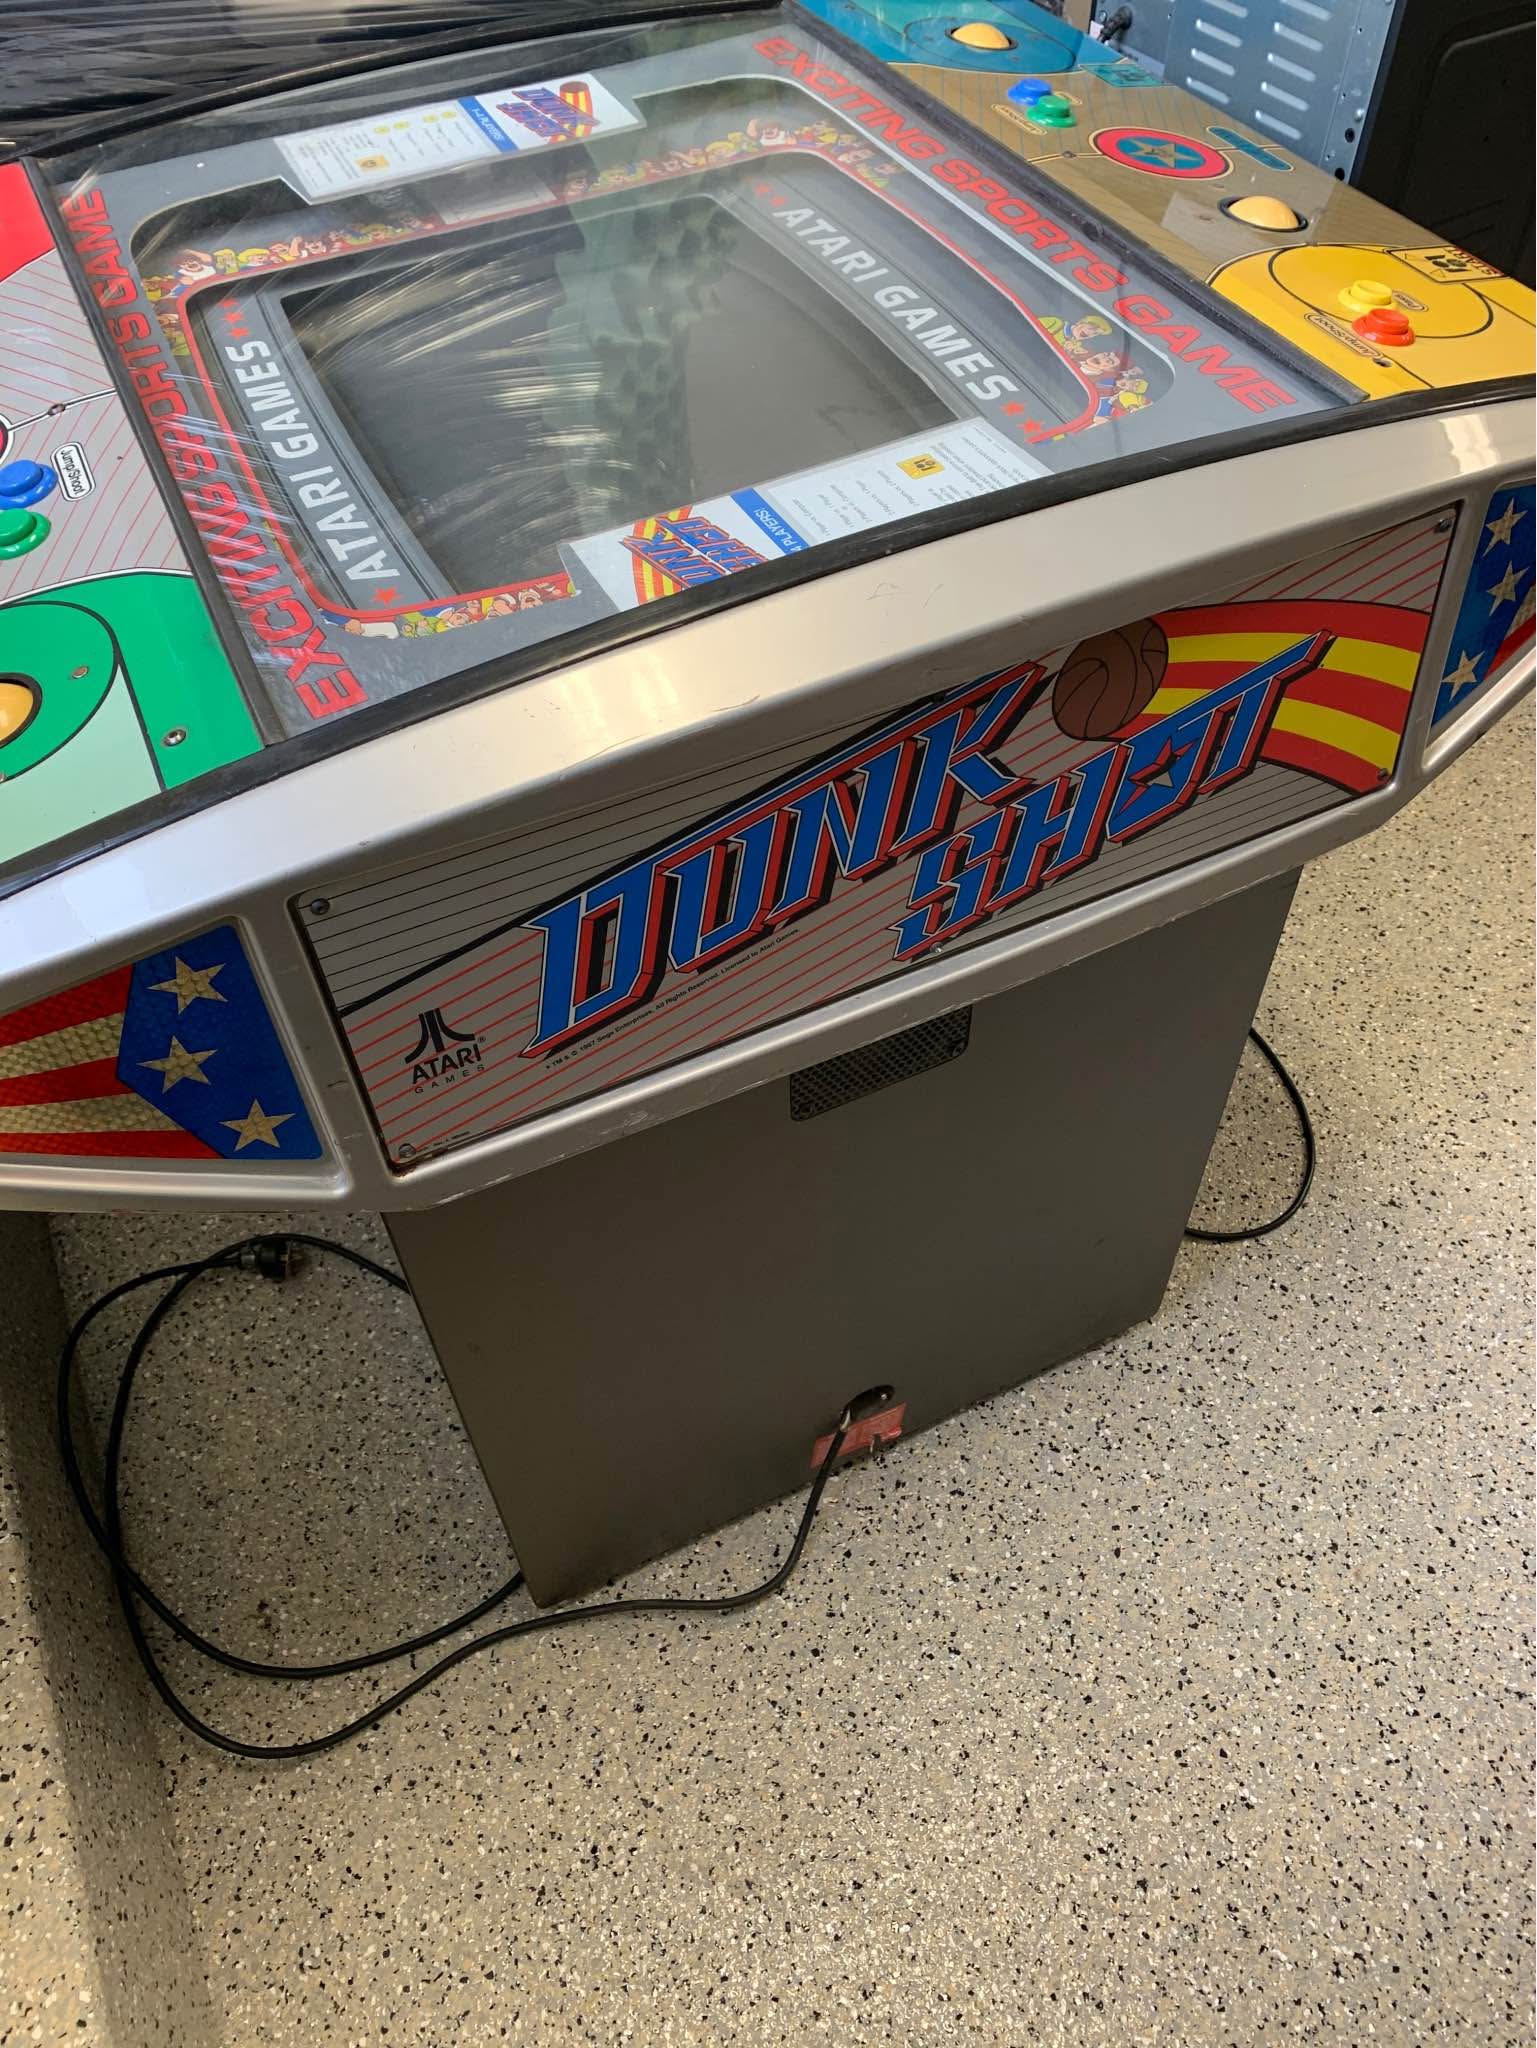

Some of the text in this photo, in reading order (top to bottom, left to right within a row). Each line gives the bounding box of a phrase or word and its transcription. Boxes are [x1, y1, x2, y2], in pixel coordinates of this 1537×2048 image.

[753, 36, 1298, 414] EXCITING SPORTS GAME
[773, 207, 1020, 401] ATARI GAMES
[61, 189, 369, 720] EXCITING SPORTS GAME
[224, 339, 401, 584] ATARI GAMES
[753, 508, 794, 550] PLAYERS!
[518, 661, 1048, 1058] DUNK
[887, 630, 1337, 962] SHOT
[414, 1063, 486, 1094] GAMES
[579, 1039, 596, 1051] 1987
[597, 1030, 615, 1043] Sega
[665, 990, 687, 1005] Rights
[720, 954, 751, 975] Licensed
[759, 941, 775, 953] Atari
